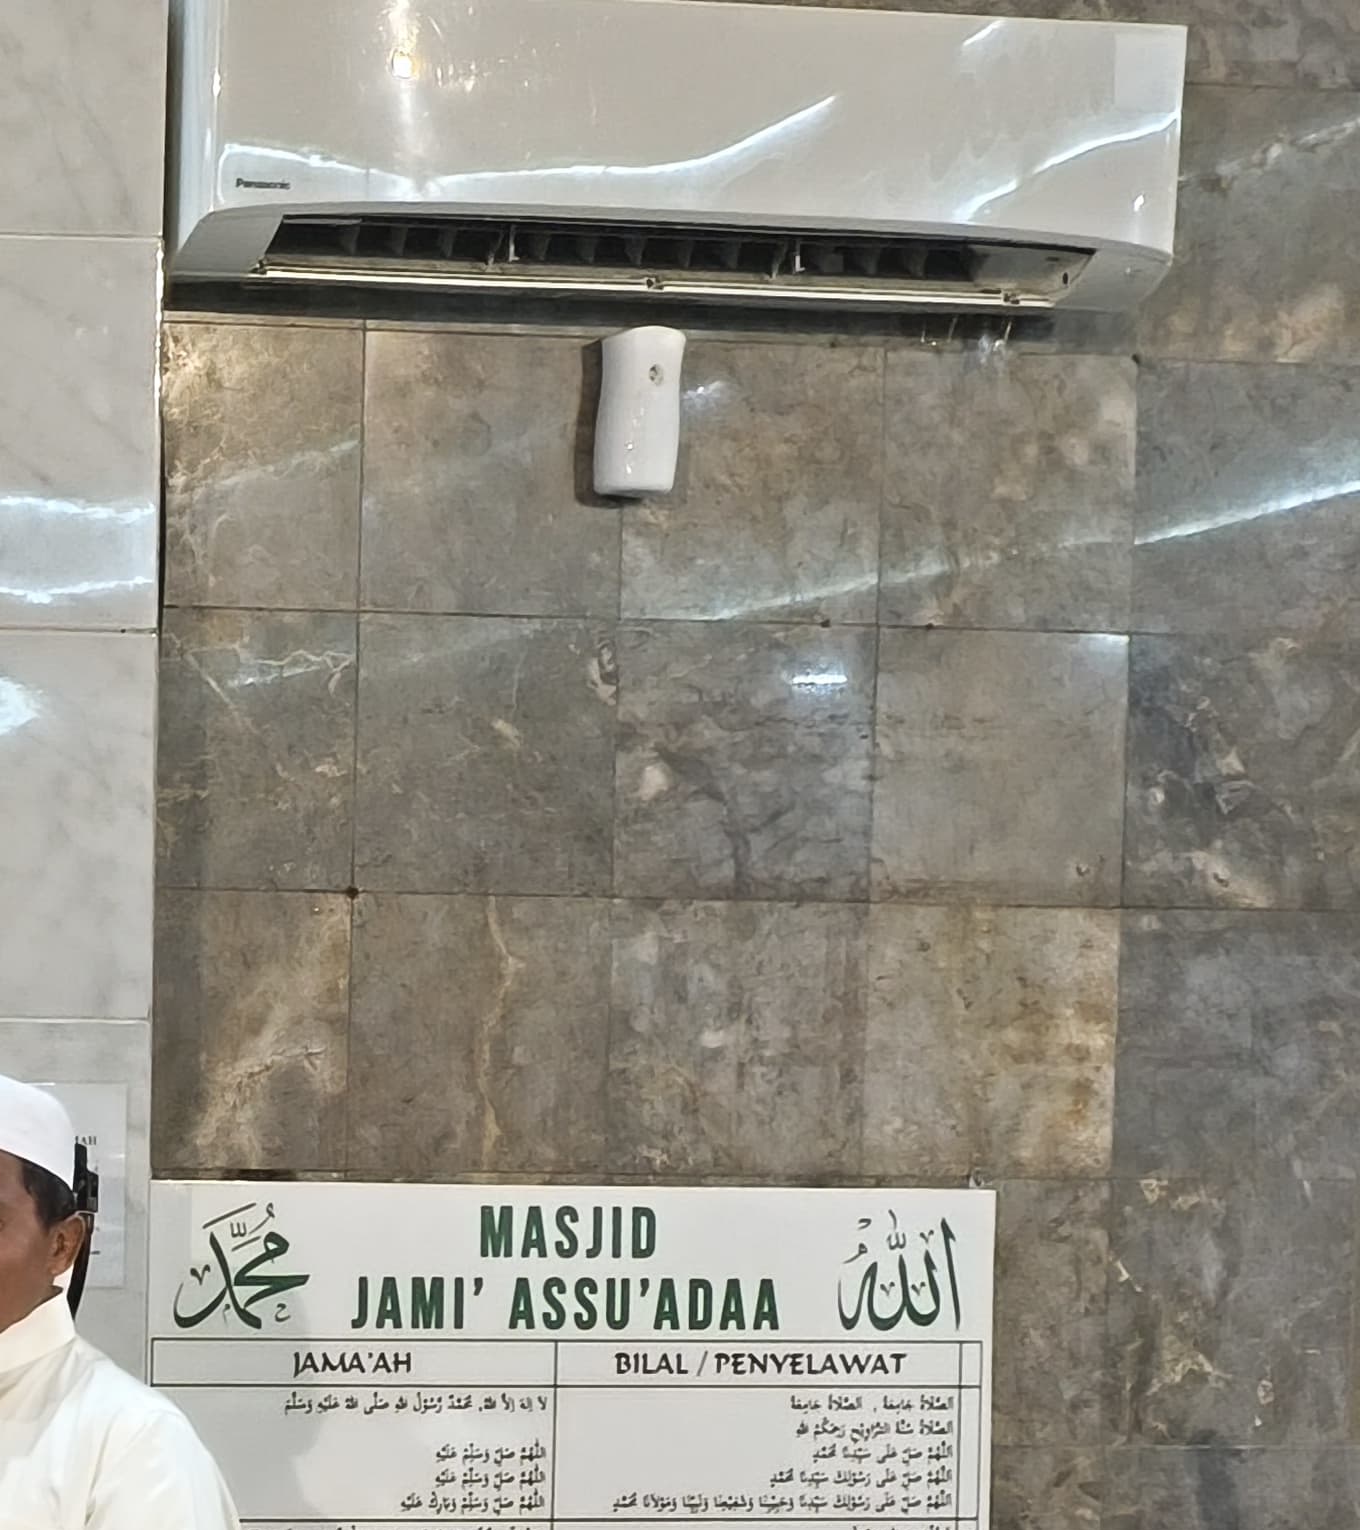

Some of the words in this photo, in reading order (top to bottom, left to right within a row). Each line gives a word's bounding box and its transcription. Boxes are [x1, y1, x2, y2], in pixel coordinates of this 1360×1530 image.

[481, 1205, 656, 1258] MASJID
[615, 1353, 688, 1374] BILAL
[696, 1350, 708, 1376] /
[714, 1353, 907, 1375] PENYELAWAT
